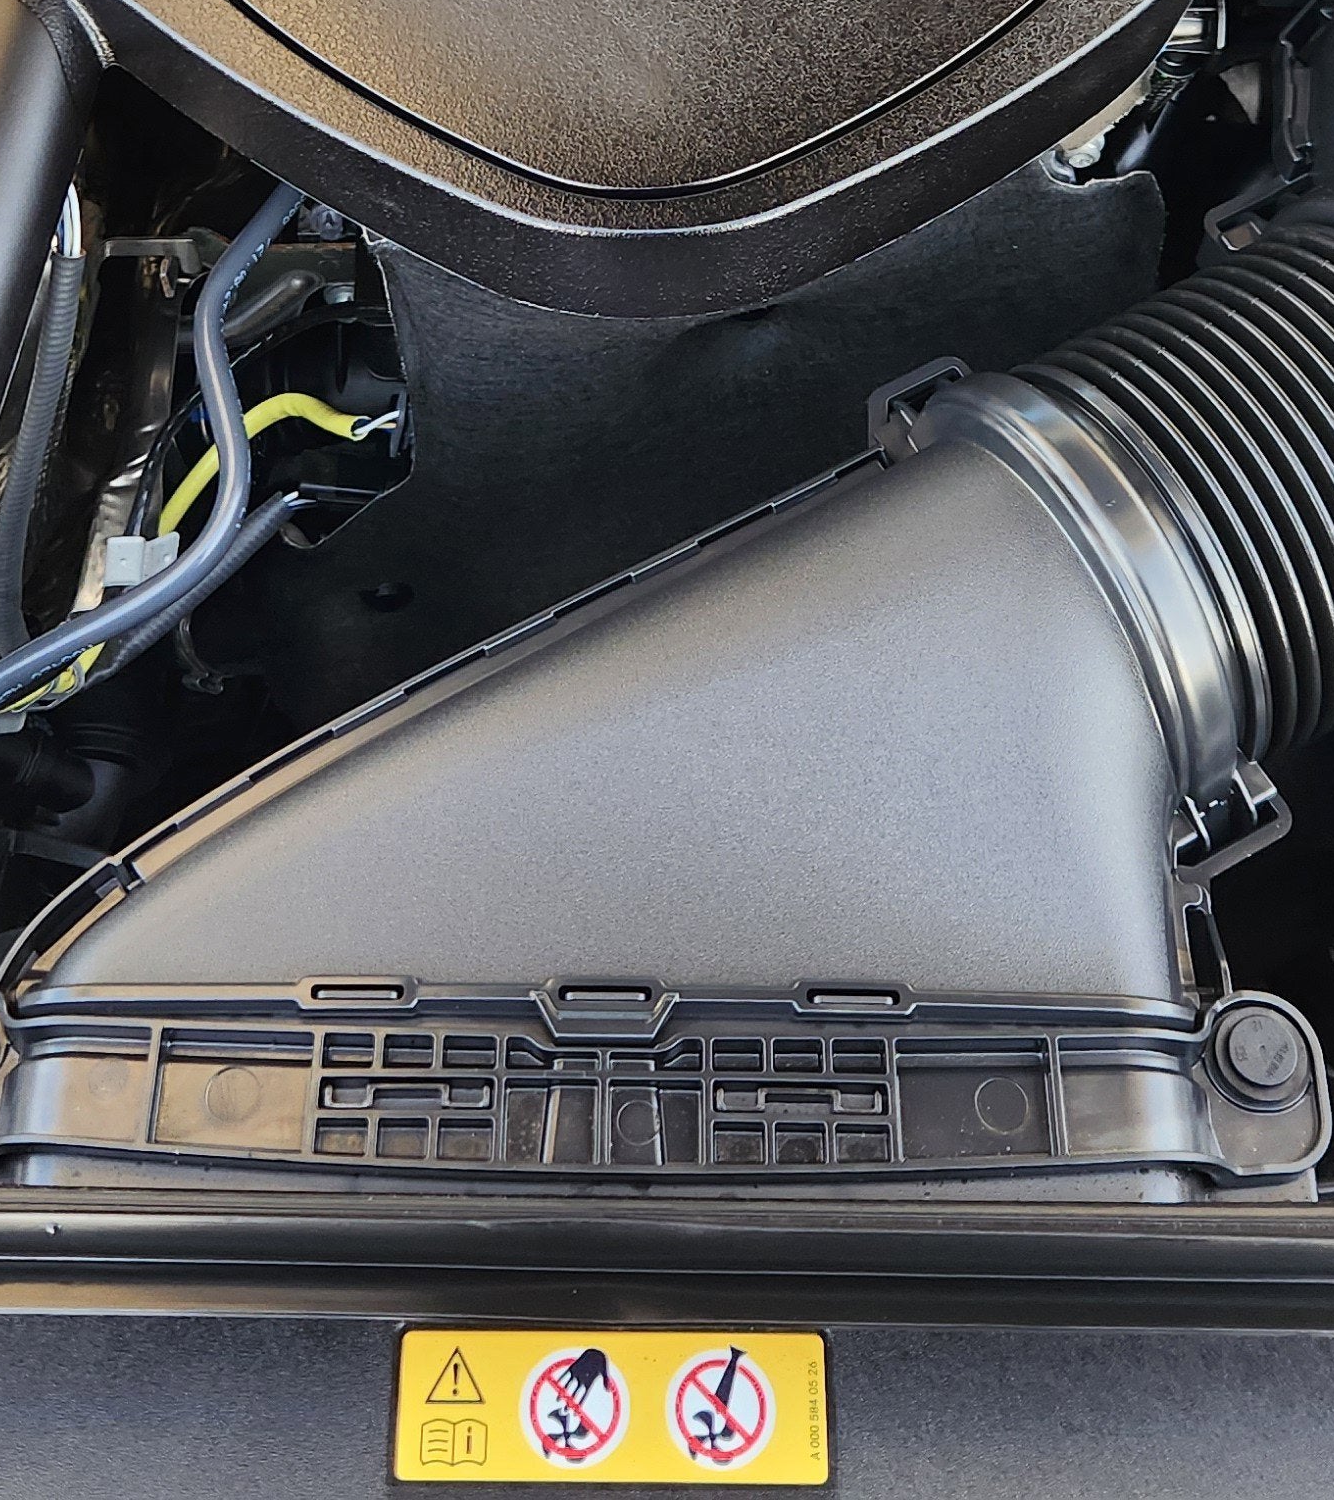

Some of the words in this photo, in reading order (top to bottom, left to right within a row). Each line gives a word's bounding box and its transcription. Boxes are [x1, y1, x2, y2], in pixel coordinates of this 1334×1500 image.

[808, 1361, 818, 1376] 26
[808, 1380, 819, 1395] 05
[809, 1398, 819, 1421] 584
[810, 1425, 820, 1448] 000
[810, 1451, 821, 1461] A
